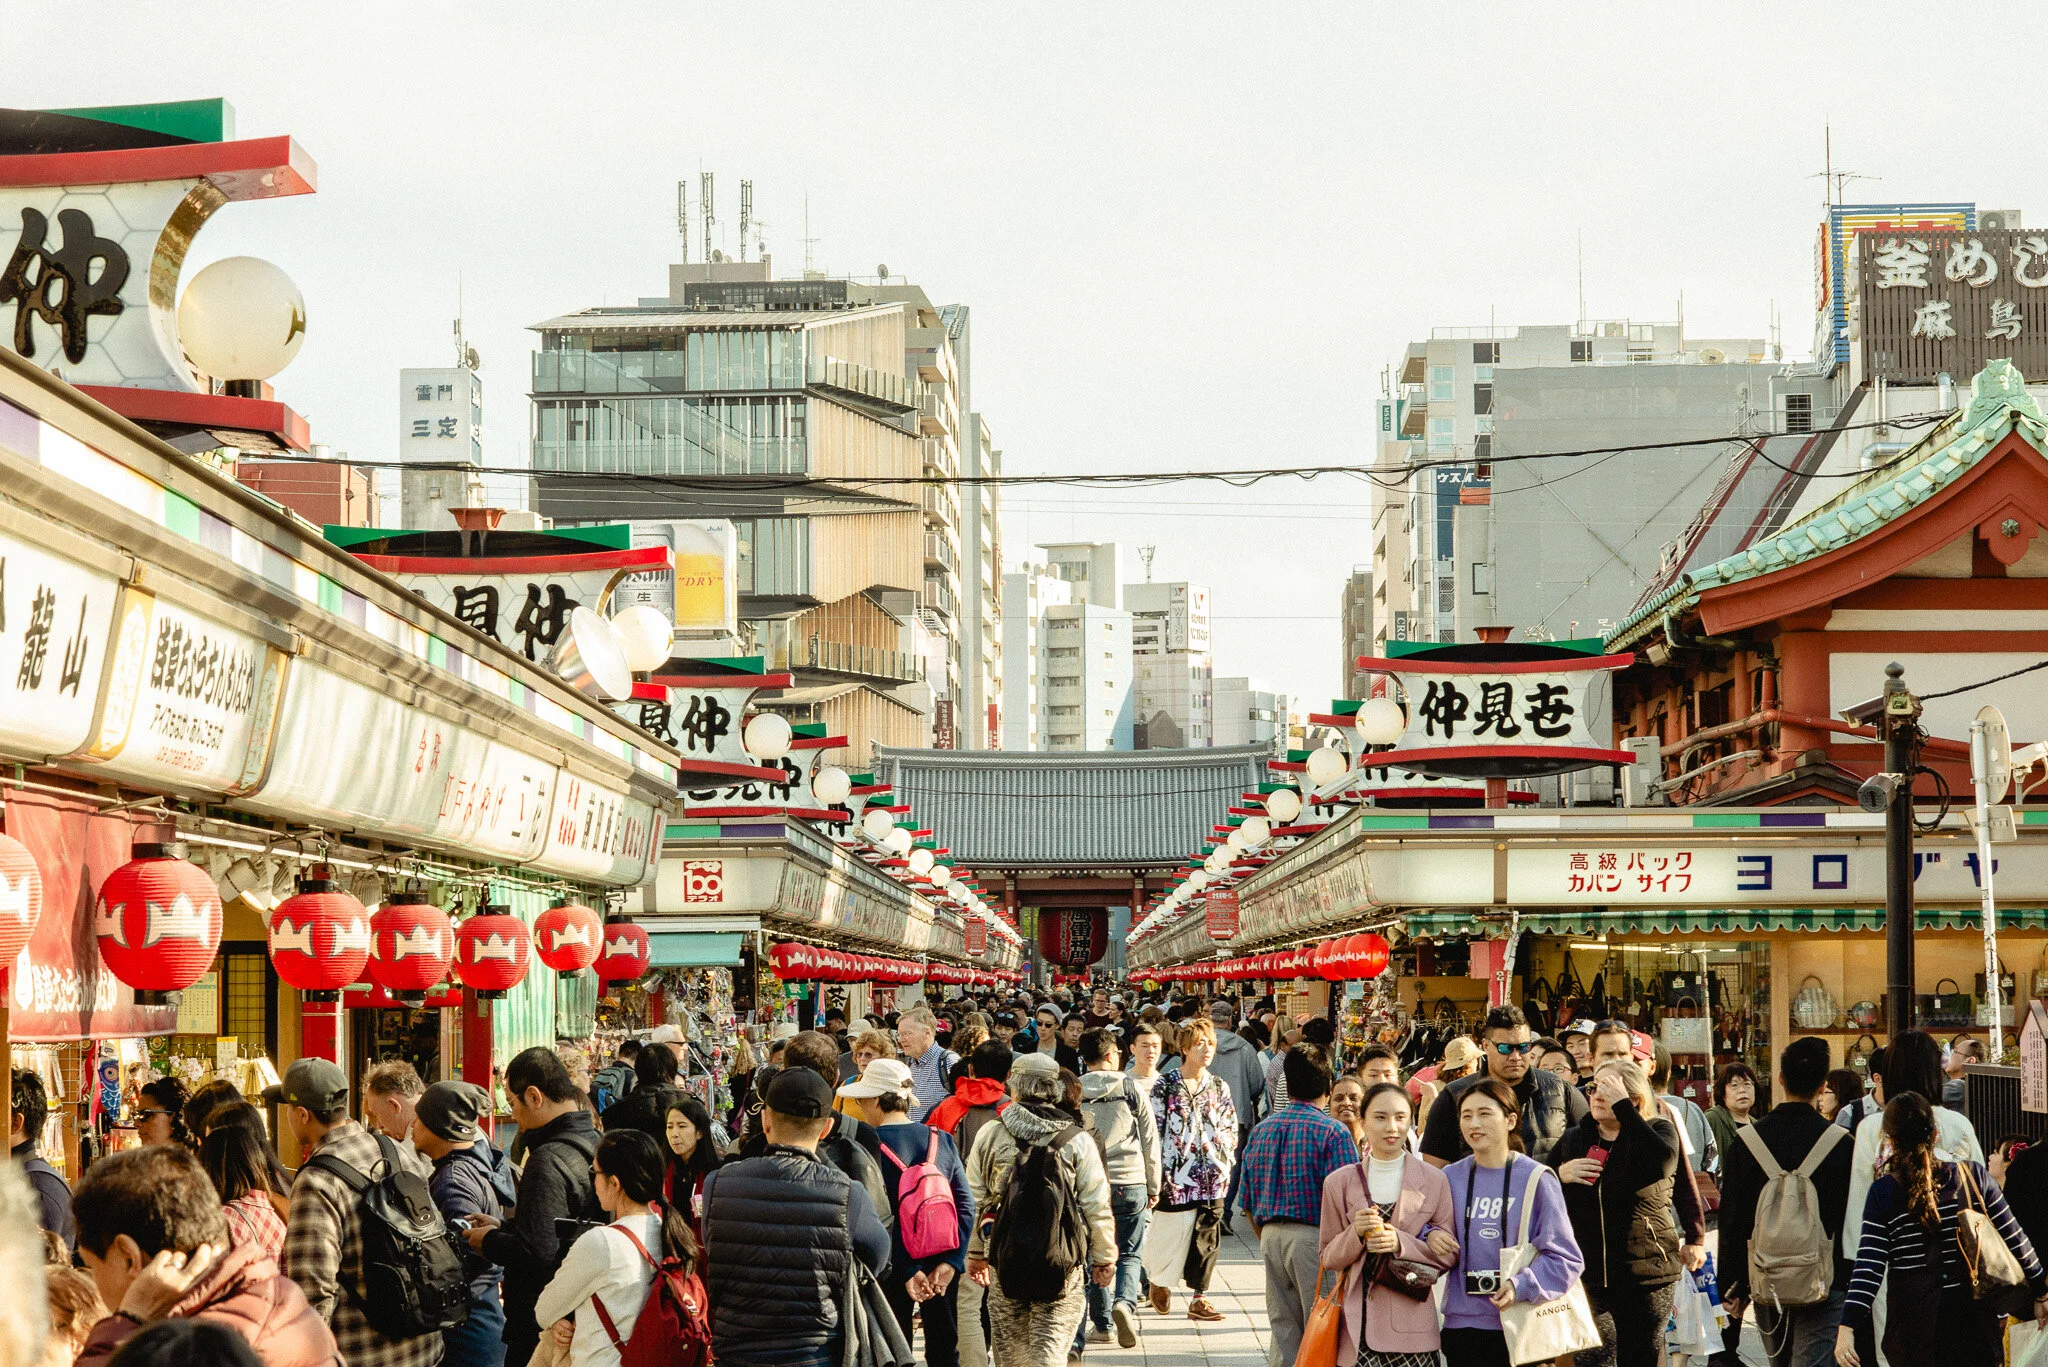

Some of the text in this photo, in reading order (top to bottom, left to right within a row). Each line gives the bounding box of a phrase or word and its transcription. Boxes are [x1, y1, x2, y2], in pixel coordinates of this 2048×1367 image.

[1911, 297, 2024, 341] 麻鳥
[415, 384, 453, 401] 雷門
[411, 416, 458, 439] 三定
[637, 592, 651, 602] 生
[0, 556, 88, 699] 龍山
[1568, 874, 1692, 893] カバン サイフ
[1535, 1303, 1573, 1318] KANGOL
